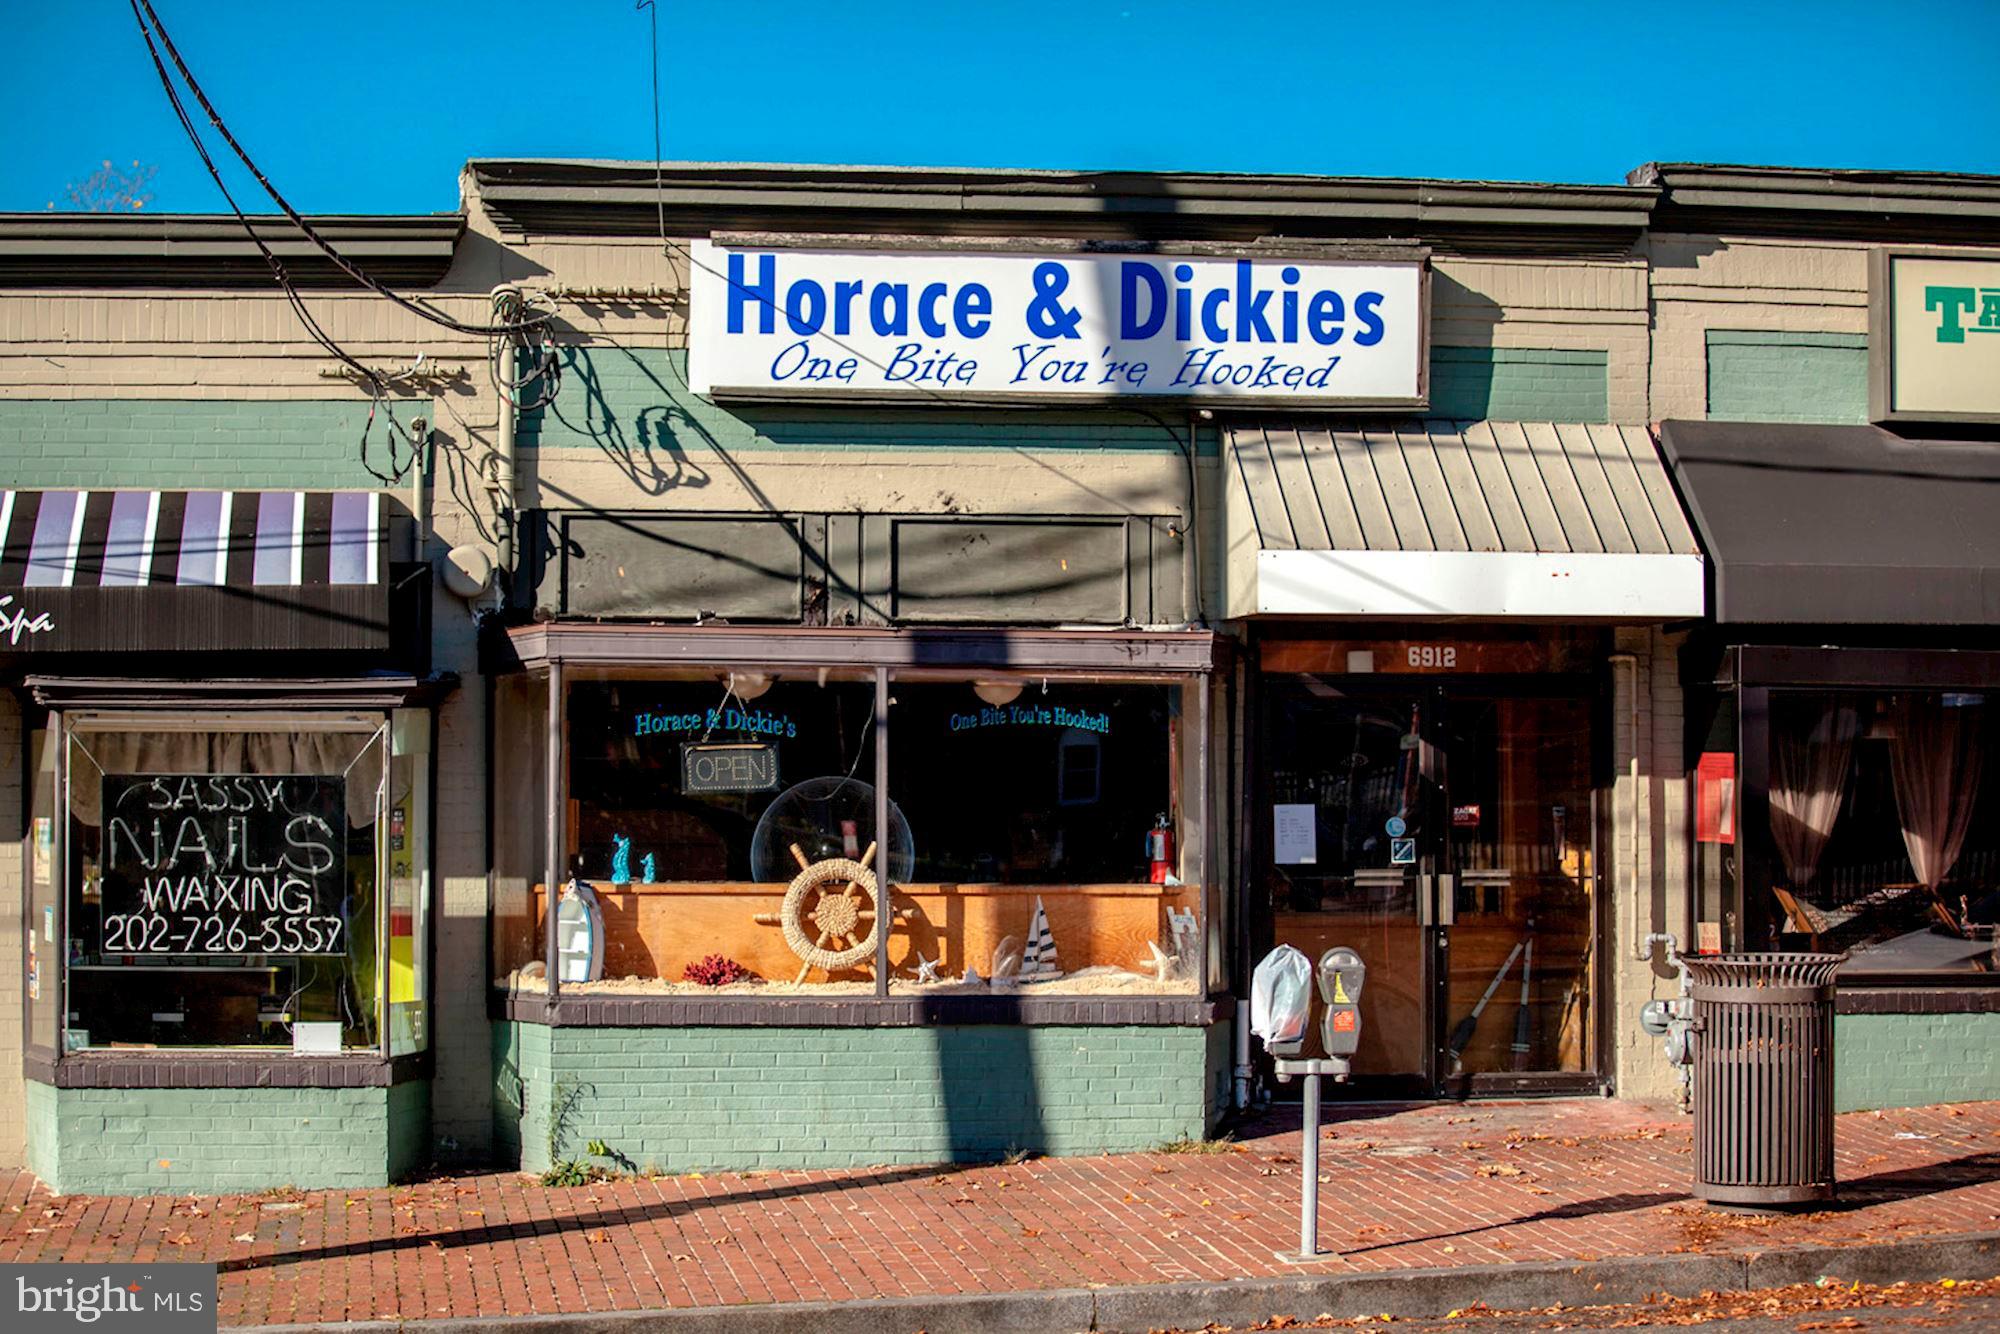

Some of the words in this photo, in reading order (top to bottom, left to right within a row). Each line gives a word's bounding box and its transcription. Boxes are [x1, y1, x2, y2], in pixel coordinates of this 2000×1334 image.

[727, 253, 992, 339] Horace
[1026, 261, 1082, 340] &
[1120, 259, 1385, 347] Dickies
[770, 340, 859, 384] One
[883, 342, 978, 387] Bite
[1009, 344, 1149, 388] You're
[1169, 348, 1342, 390] Hooked
[0, 595, 55, 646] Spa
[1408, 646, 1456, 667] 6912
[634, 713, 702, 737] Horace
[705, 708, 721, 729] &
[725, 708, 798, 738] Dickie's
[950, 713, 978, 732] One
[980, 708, 1007, 726] Bite
[1009, 704, 1052, 724] You're
[1053, 706, 1109, 734] Hooked!
[695, 754, 766, 782] OPEN
[148, 777, 283, 812] SASSY
[109, 815, 334, 874] NAILS
[144, 876, 312, 914] WAXING
[104, 914, 342, 952] 202-726-5557
